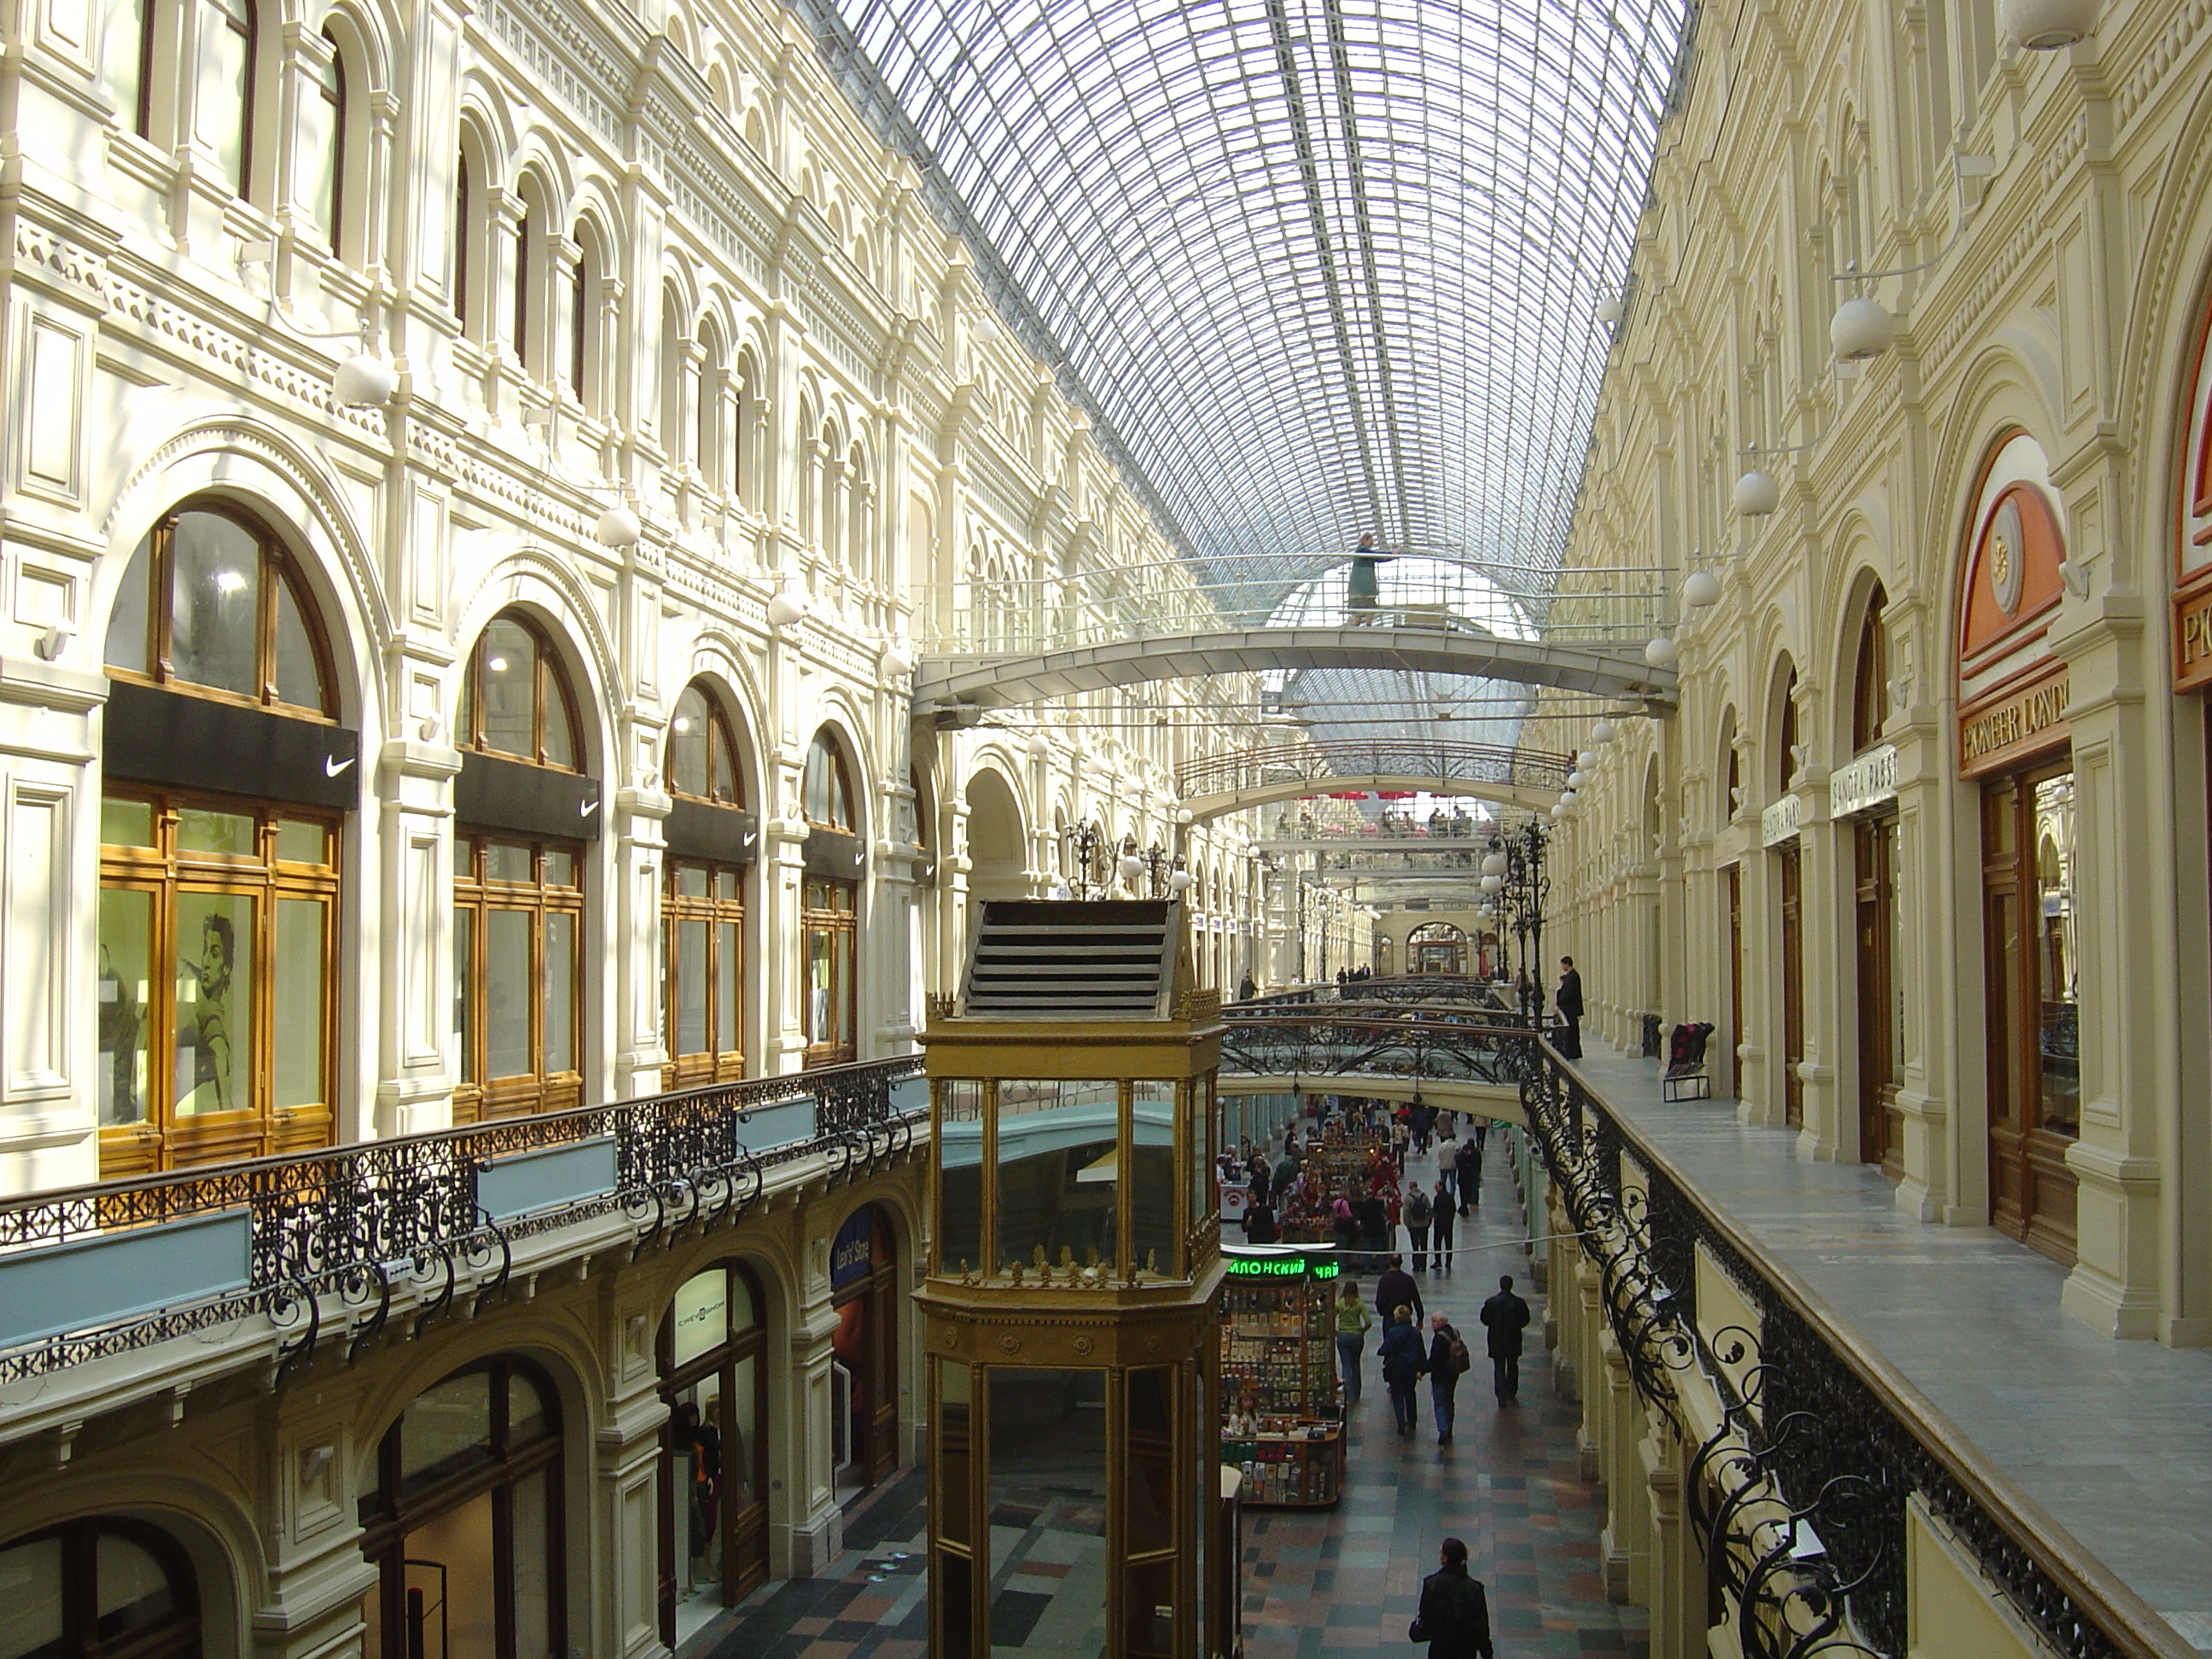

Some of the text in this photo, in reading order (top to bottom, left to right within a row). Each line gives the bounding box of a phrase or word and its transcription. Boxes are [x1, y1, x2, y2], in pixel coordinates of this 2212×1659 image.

[2185, 602, 2212, 664] PI
[1964, 706, 2021, 761] PIONEER
[1833, 768, 1865, 810] SANDRA
[1227, 1259, 1339, 1278] ЙЛОНСКИЙ ЧАЙ
